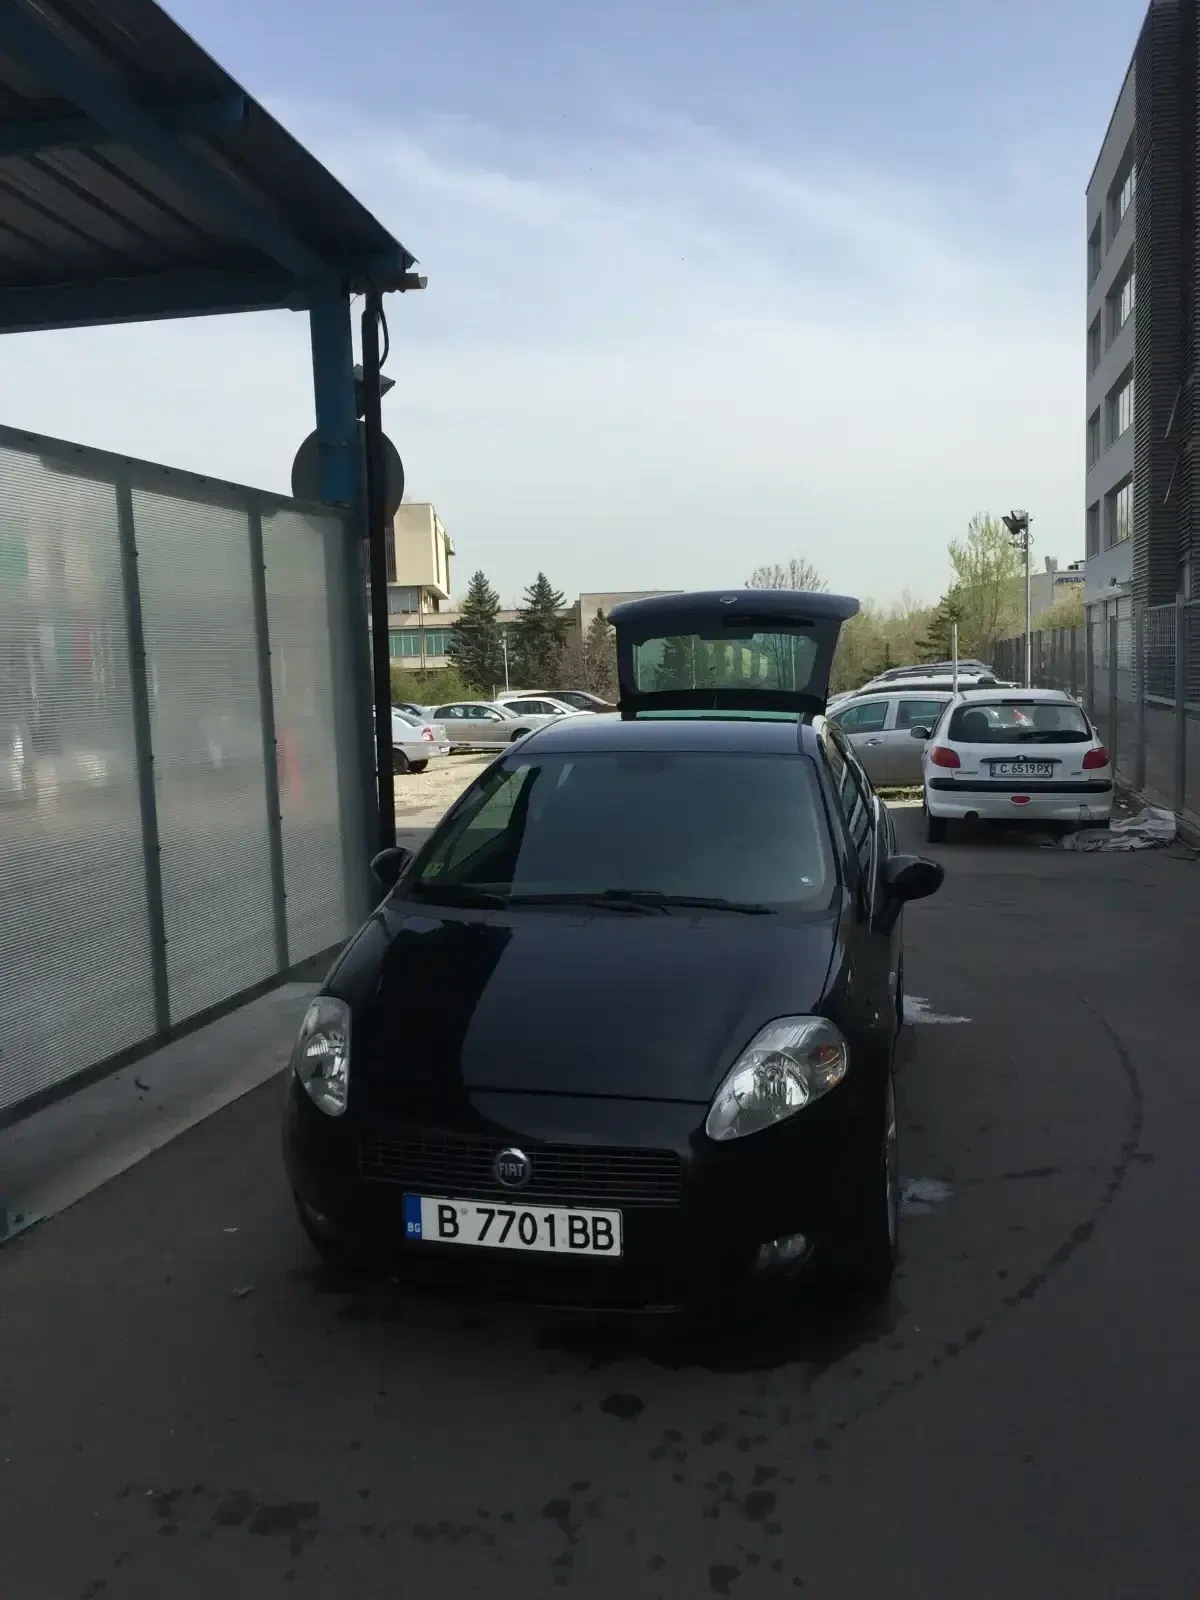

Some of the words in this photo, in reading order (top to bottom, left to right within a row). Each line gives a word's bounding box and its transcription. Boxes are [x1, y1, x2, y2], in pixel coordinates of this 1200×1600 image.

[499, 1163, 524, 1177] FIAT
[407, 1222, 421, 1233] BG
[437, 1204, 460, 1238] B
[475, 1207, 556, 1247] 7701
[567, 1214, 614, 1251] BB
